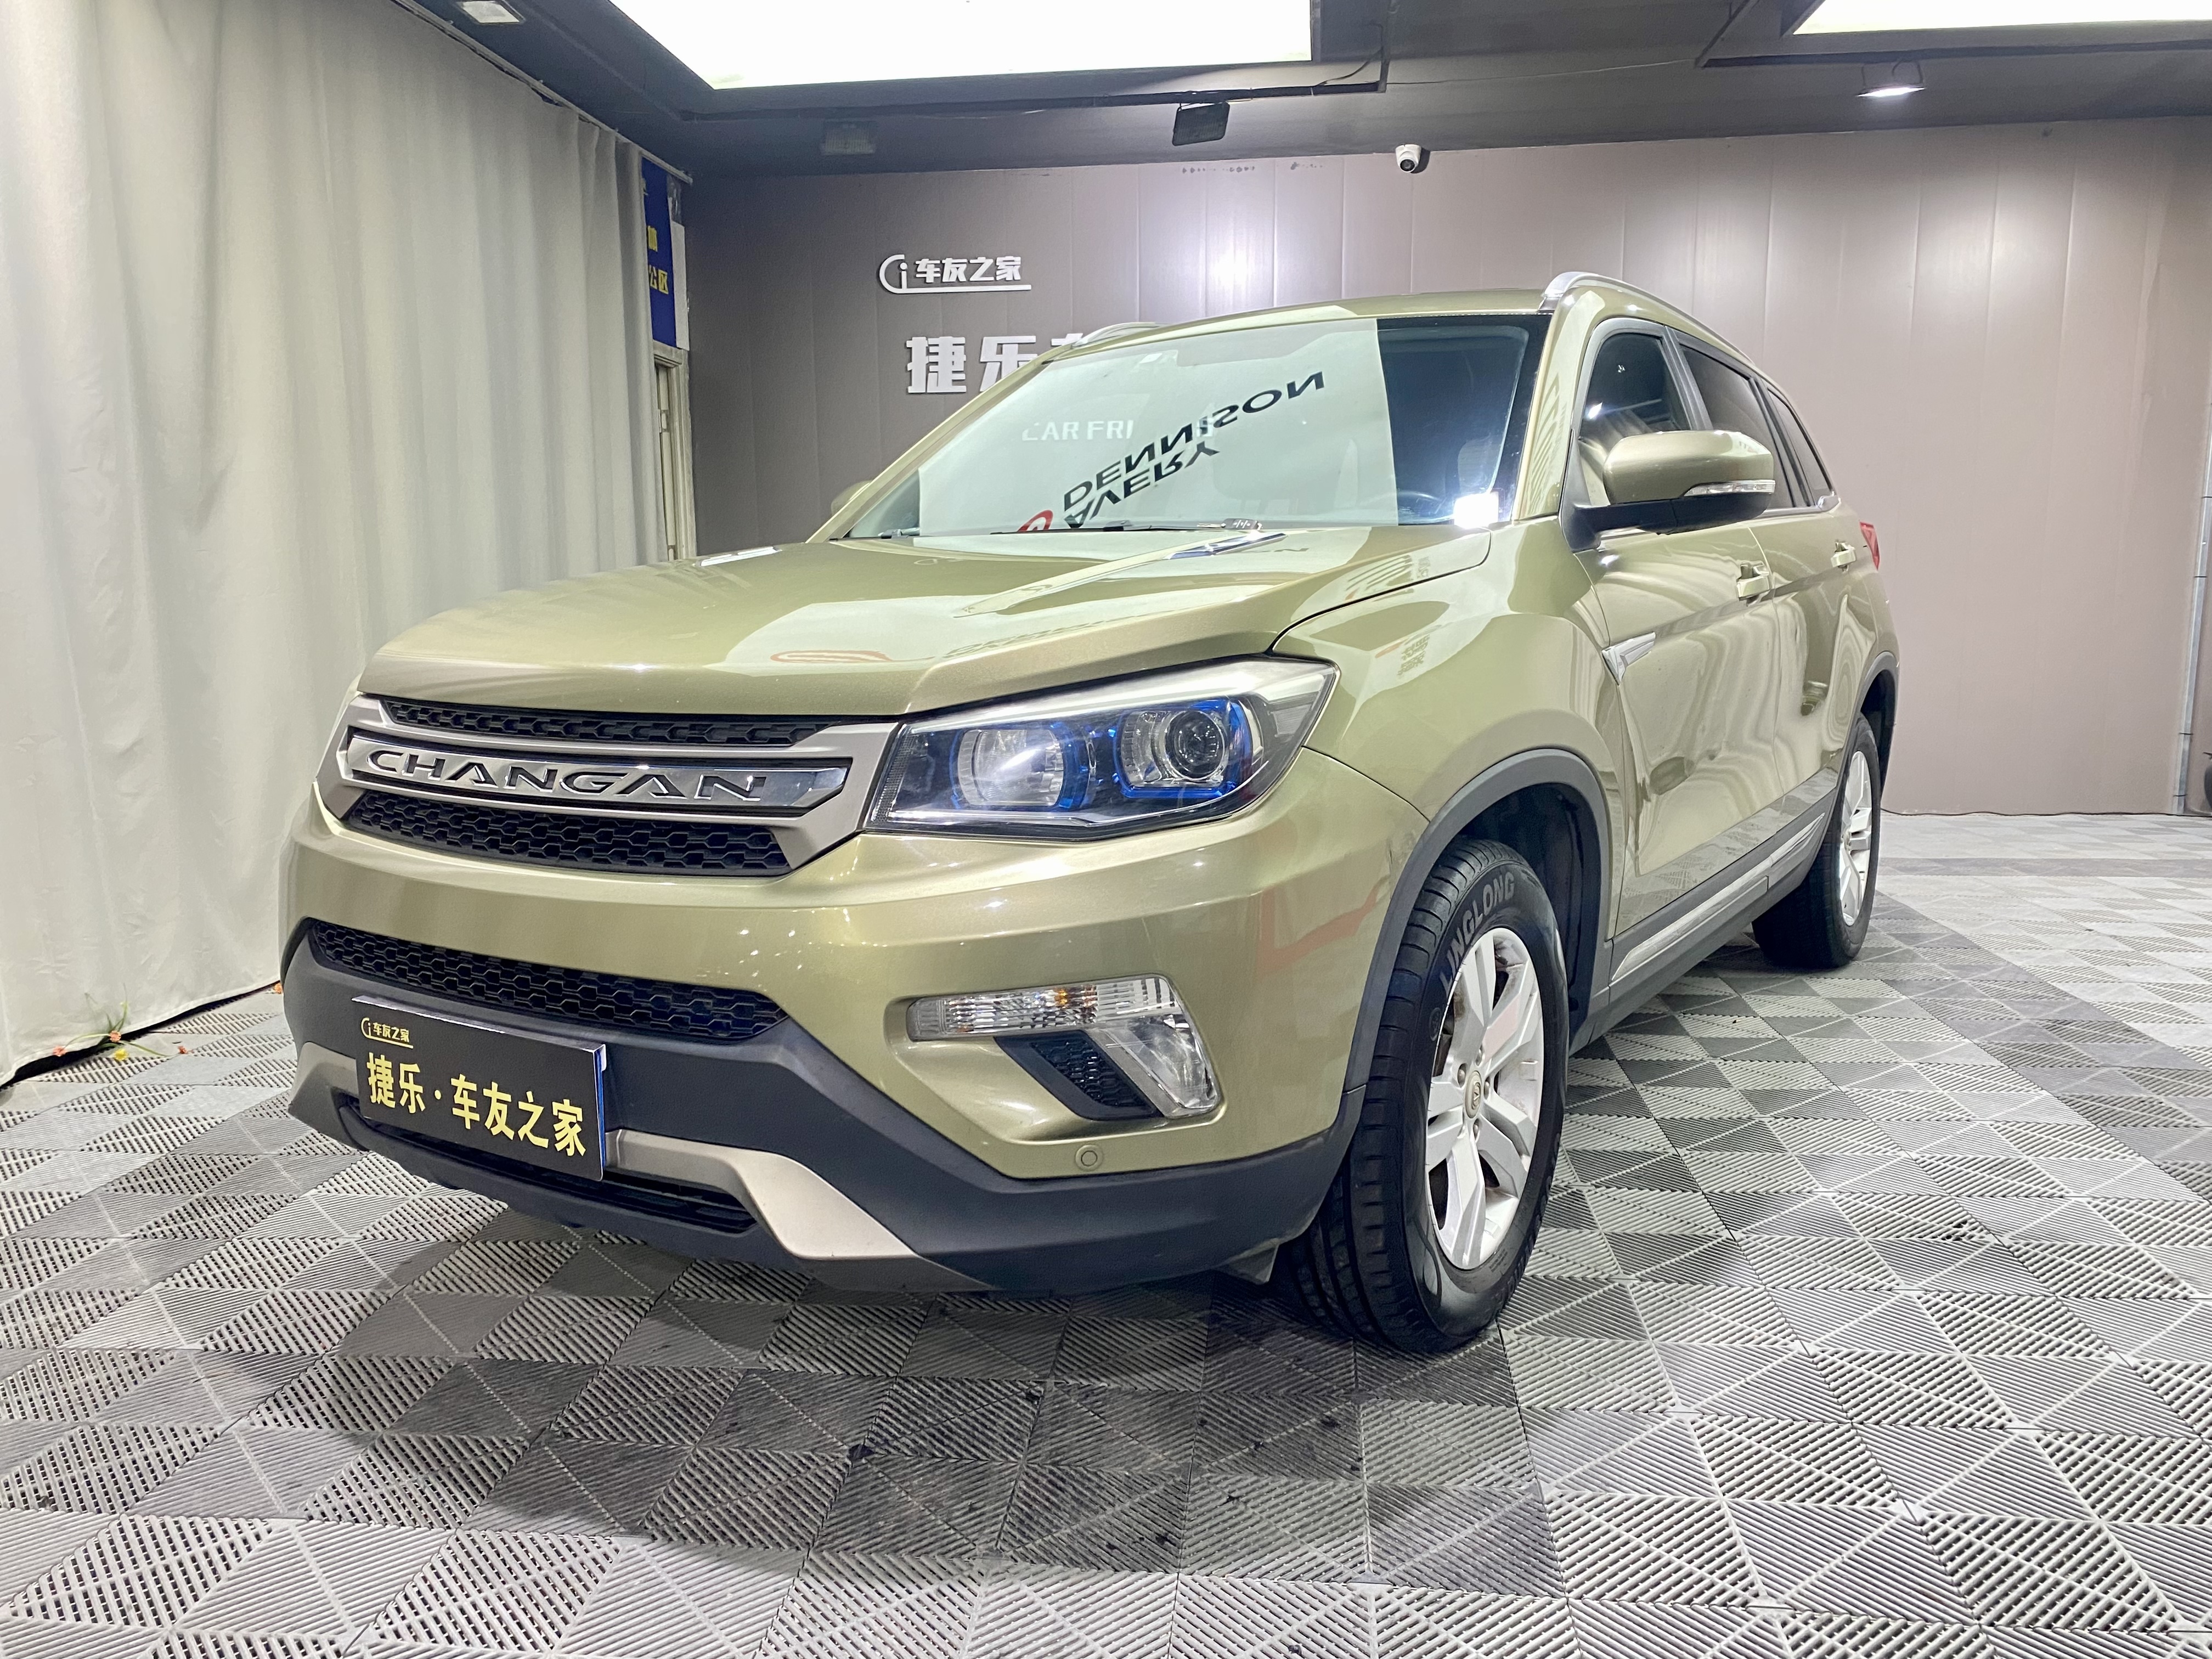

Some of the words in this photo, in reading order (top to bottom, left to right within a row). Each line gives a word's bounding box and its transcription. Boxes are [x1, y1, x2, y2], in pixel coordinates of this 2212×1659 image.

[915, 256, 1022, 283] 车友之家
[366, 749, 766, 802] CHANGAN
[373, 1022, 410, 1043] 车友之家
